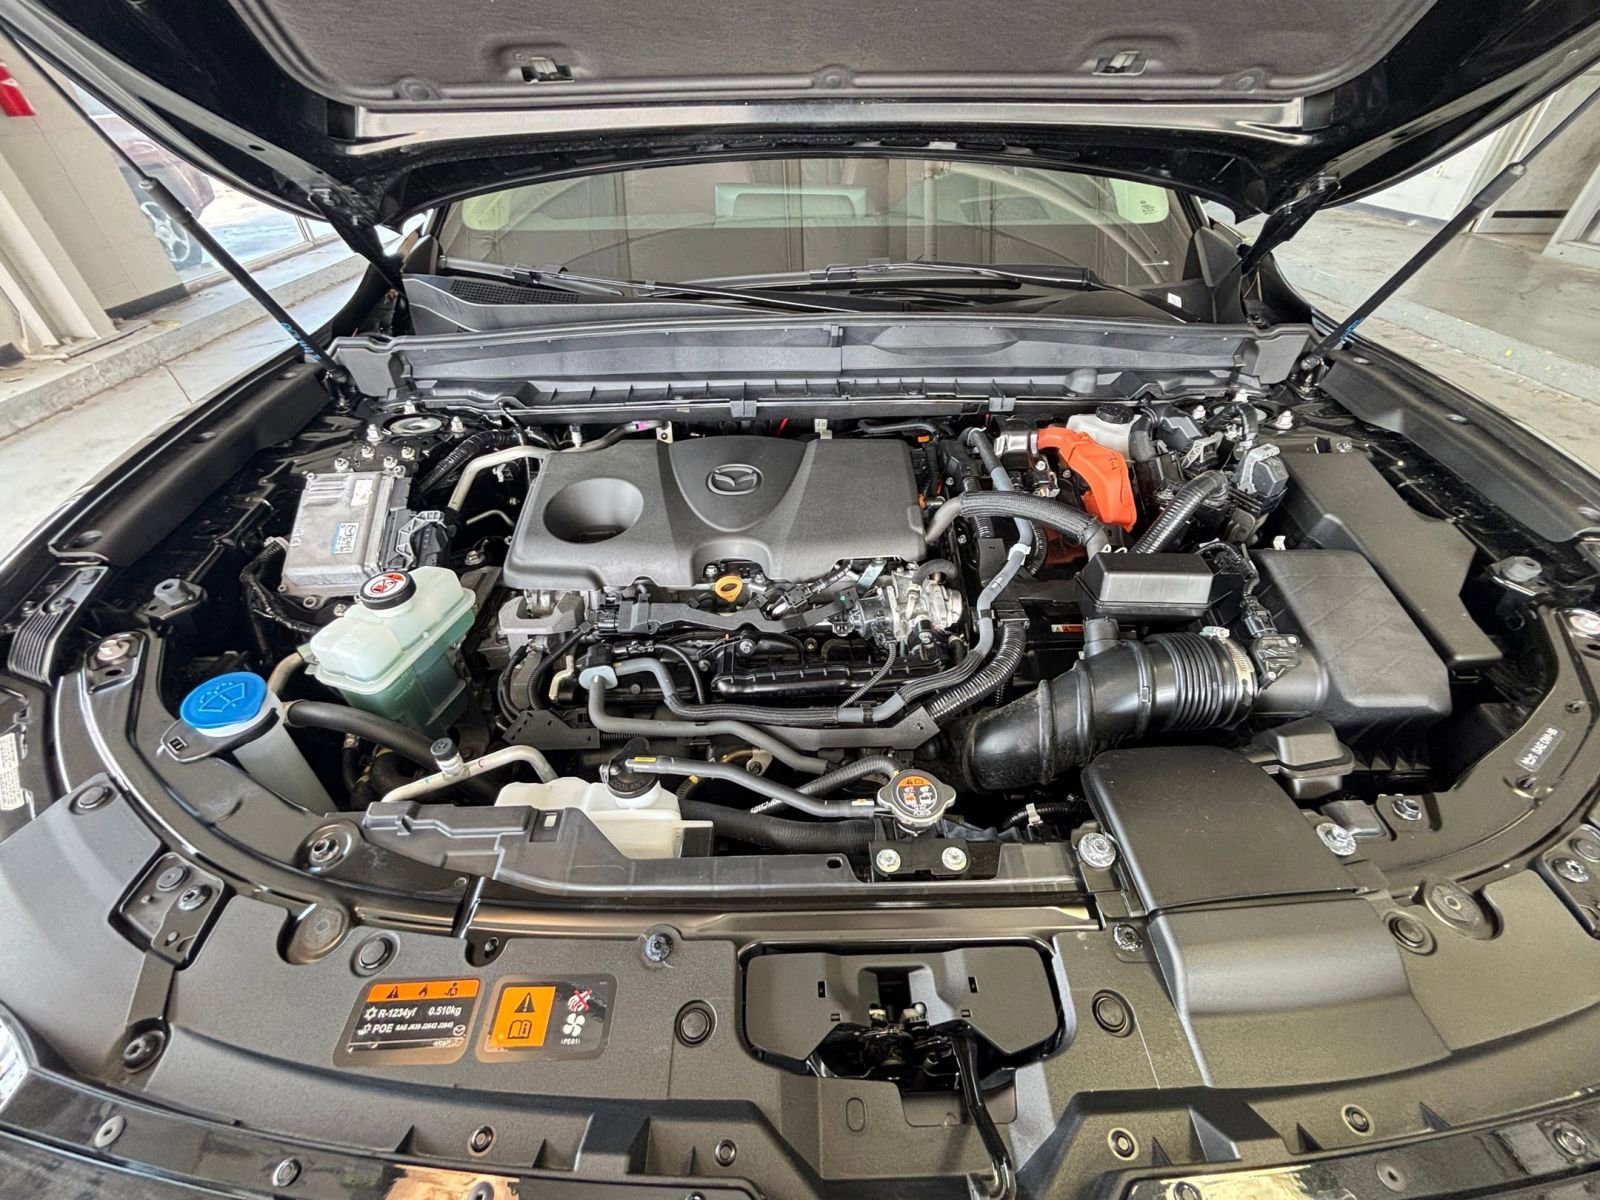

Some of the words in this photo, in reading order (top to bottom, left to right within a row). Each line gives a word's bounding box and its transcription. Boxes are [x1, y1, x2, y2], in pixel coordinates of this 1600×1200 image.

[378, 1006, 418, 1020] R-1234yf
[427, 1004, 462, 1017] 0.510kg
[371, 1023, 394, 1034] POE
